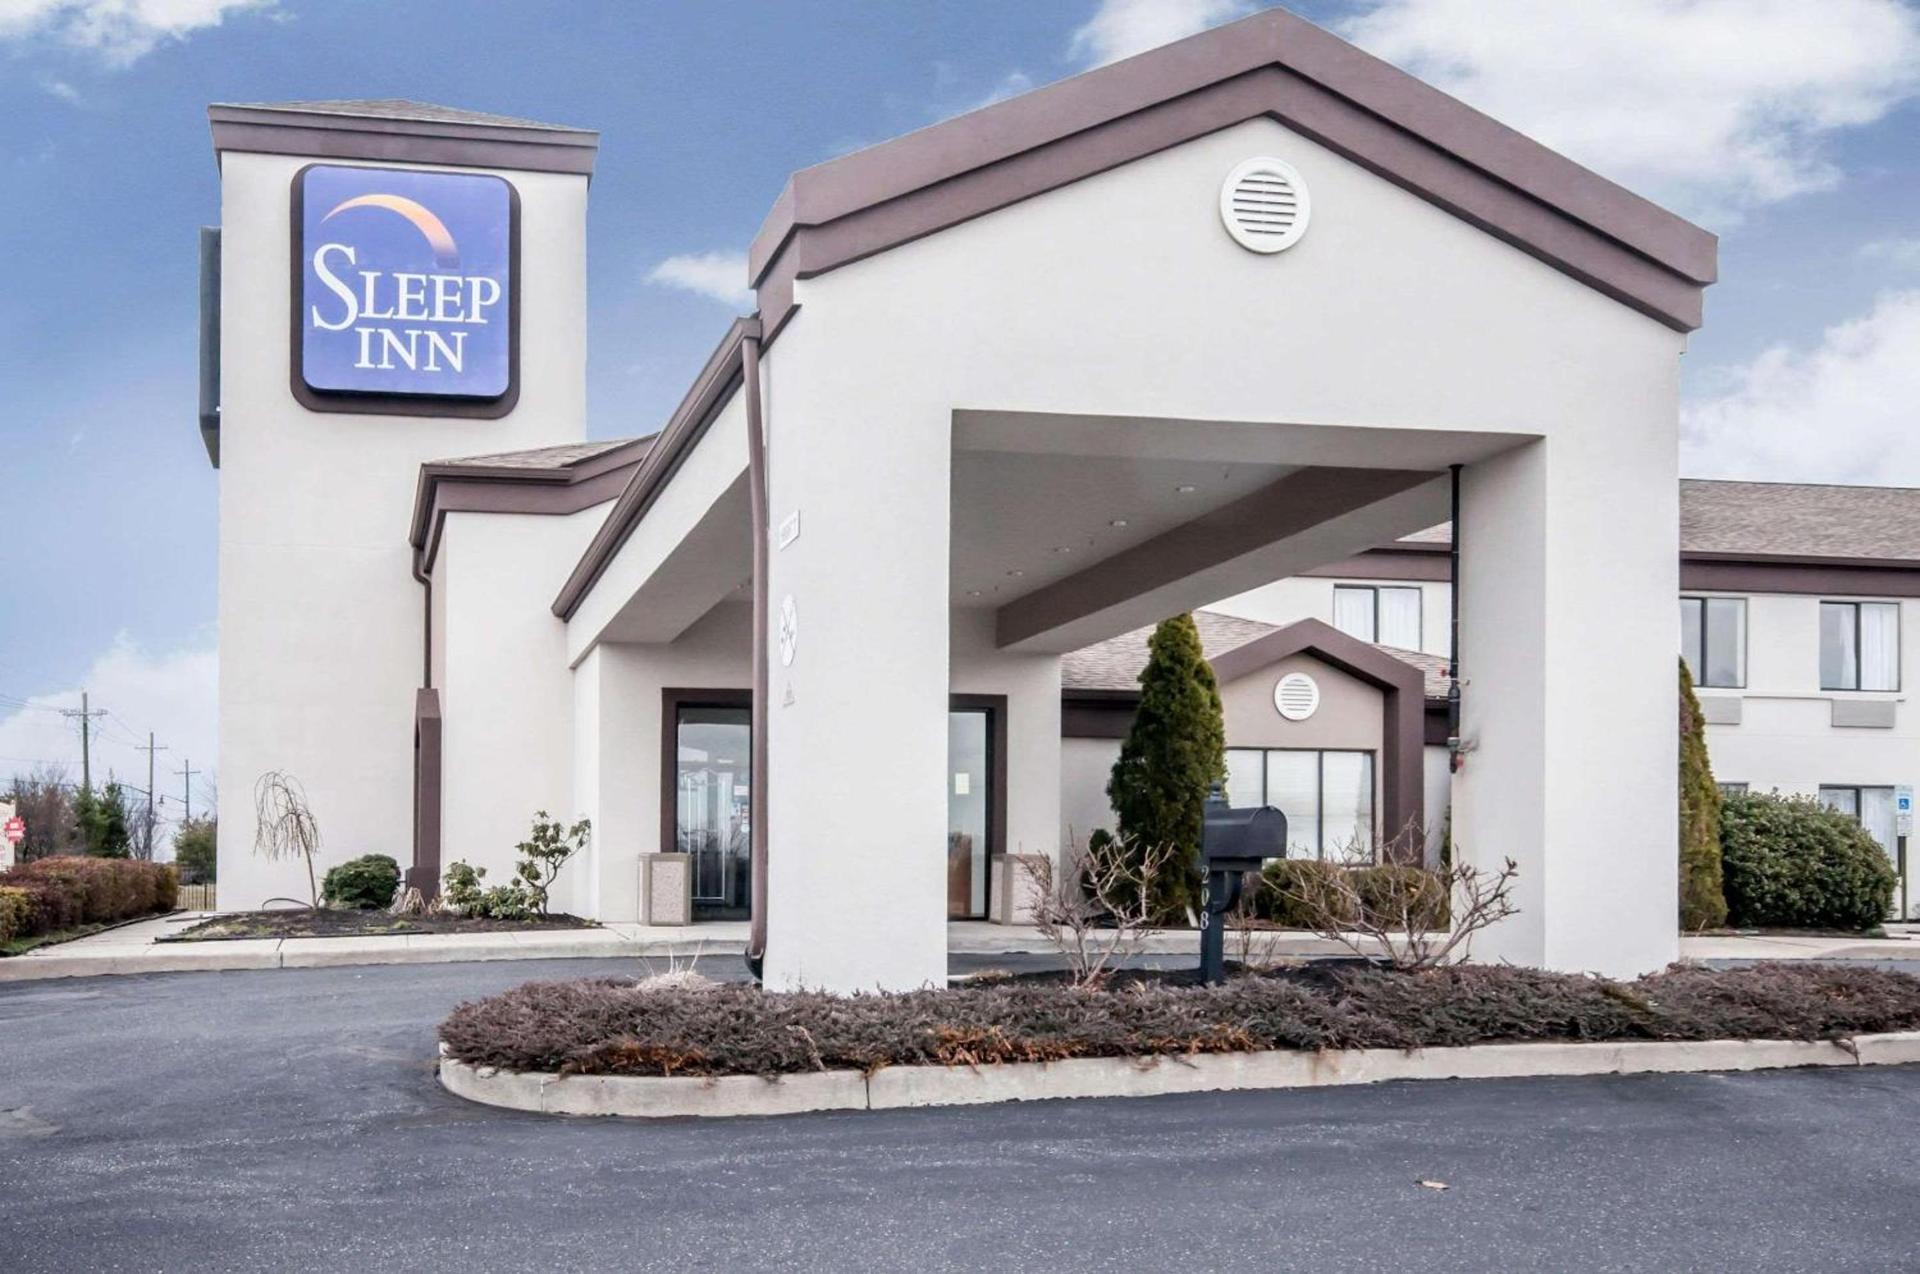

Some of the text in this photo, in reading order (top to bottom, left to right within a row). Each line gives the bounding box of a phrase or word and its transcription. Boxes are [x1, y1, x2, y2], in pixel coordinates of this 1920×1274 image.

[312, 243, 501, 331] SLEEP
[354, 327, 468, 372] INN
[1200, 866, 1210, 930] 208
